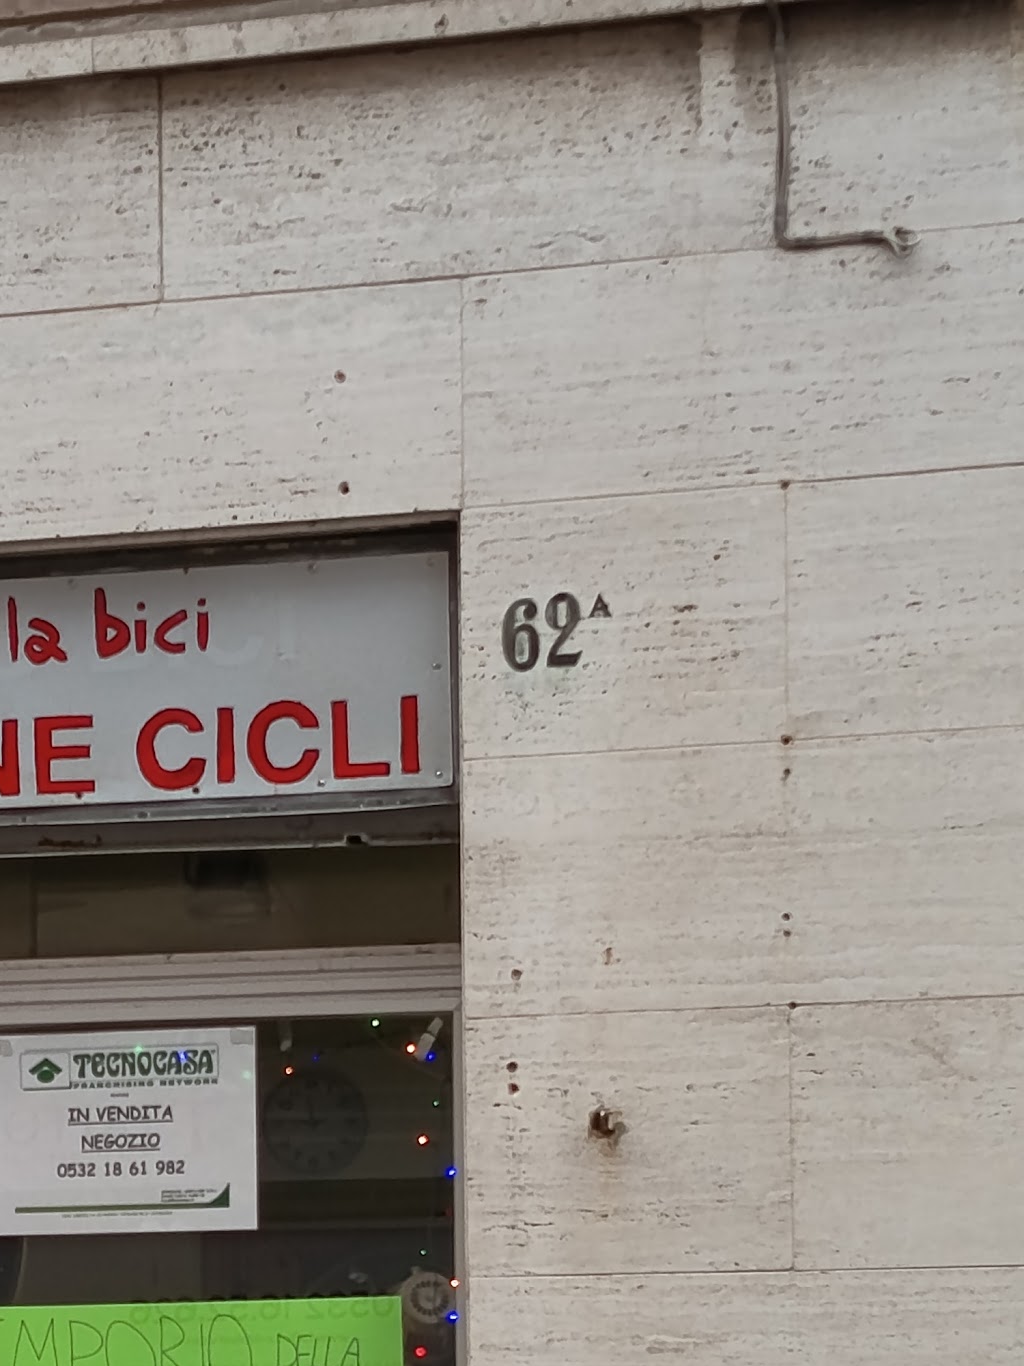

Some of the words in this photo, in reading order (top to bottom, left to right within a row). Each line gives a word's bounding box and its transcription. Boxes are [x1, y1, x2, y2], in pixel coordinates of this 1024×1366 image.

[94, 587, 211, 659] bici
[135, 695, 422, 790] CICLI
[73, 1050, 215, 1078] TECNOCASA
[68, 1107, 90, 1123] IN
[96, 1105, 173, 1122] VENDITA
[81, 1133, 160, 1150] NEGOZIO
[57, 1162, 96, 1178] 0532
[104, 1162, 123, 1176] 18
[129, 1161, 147, 1176] 61
[156, 1160, 185, 1175] 982
